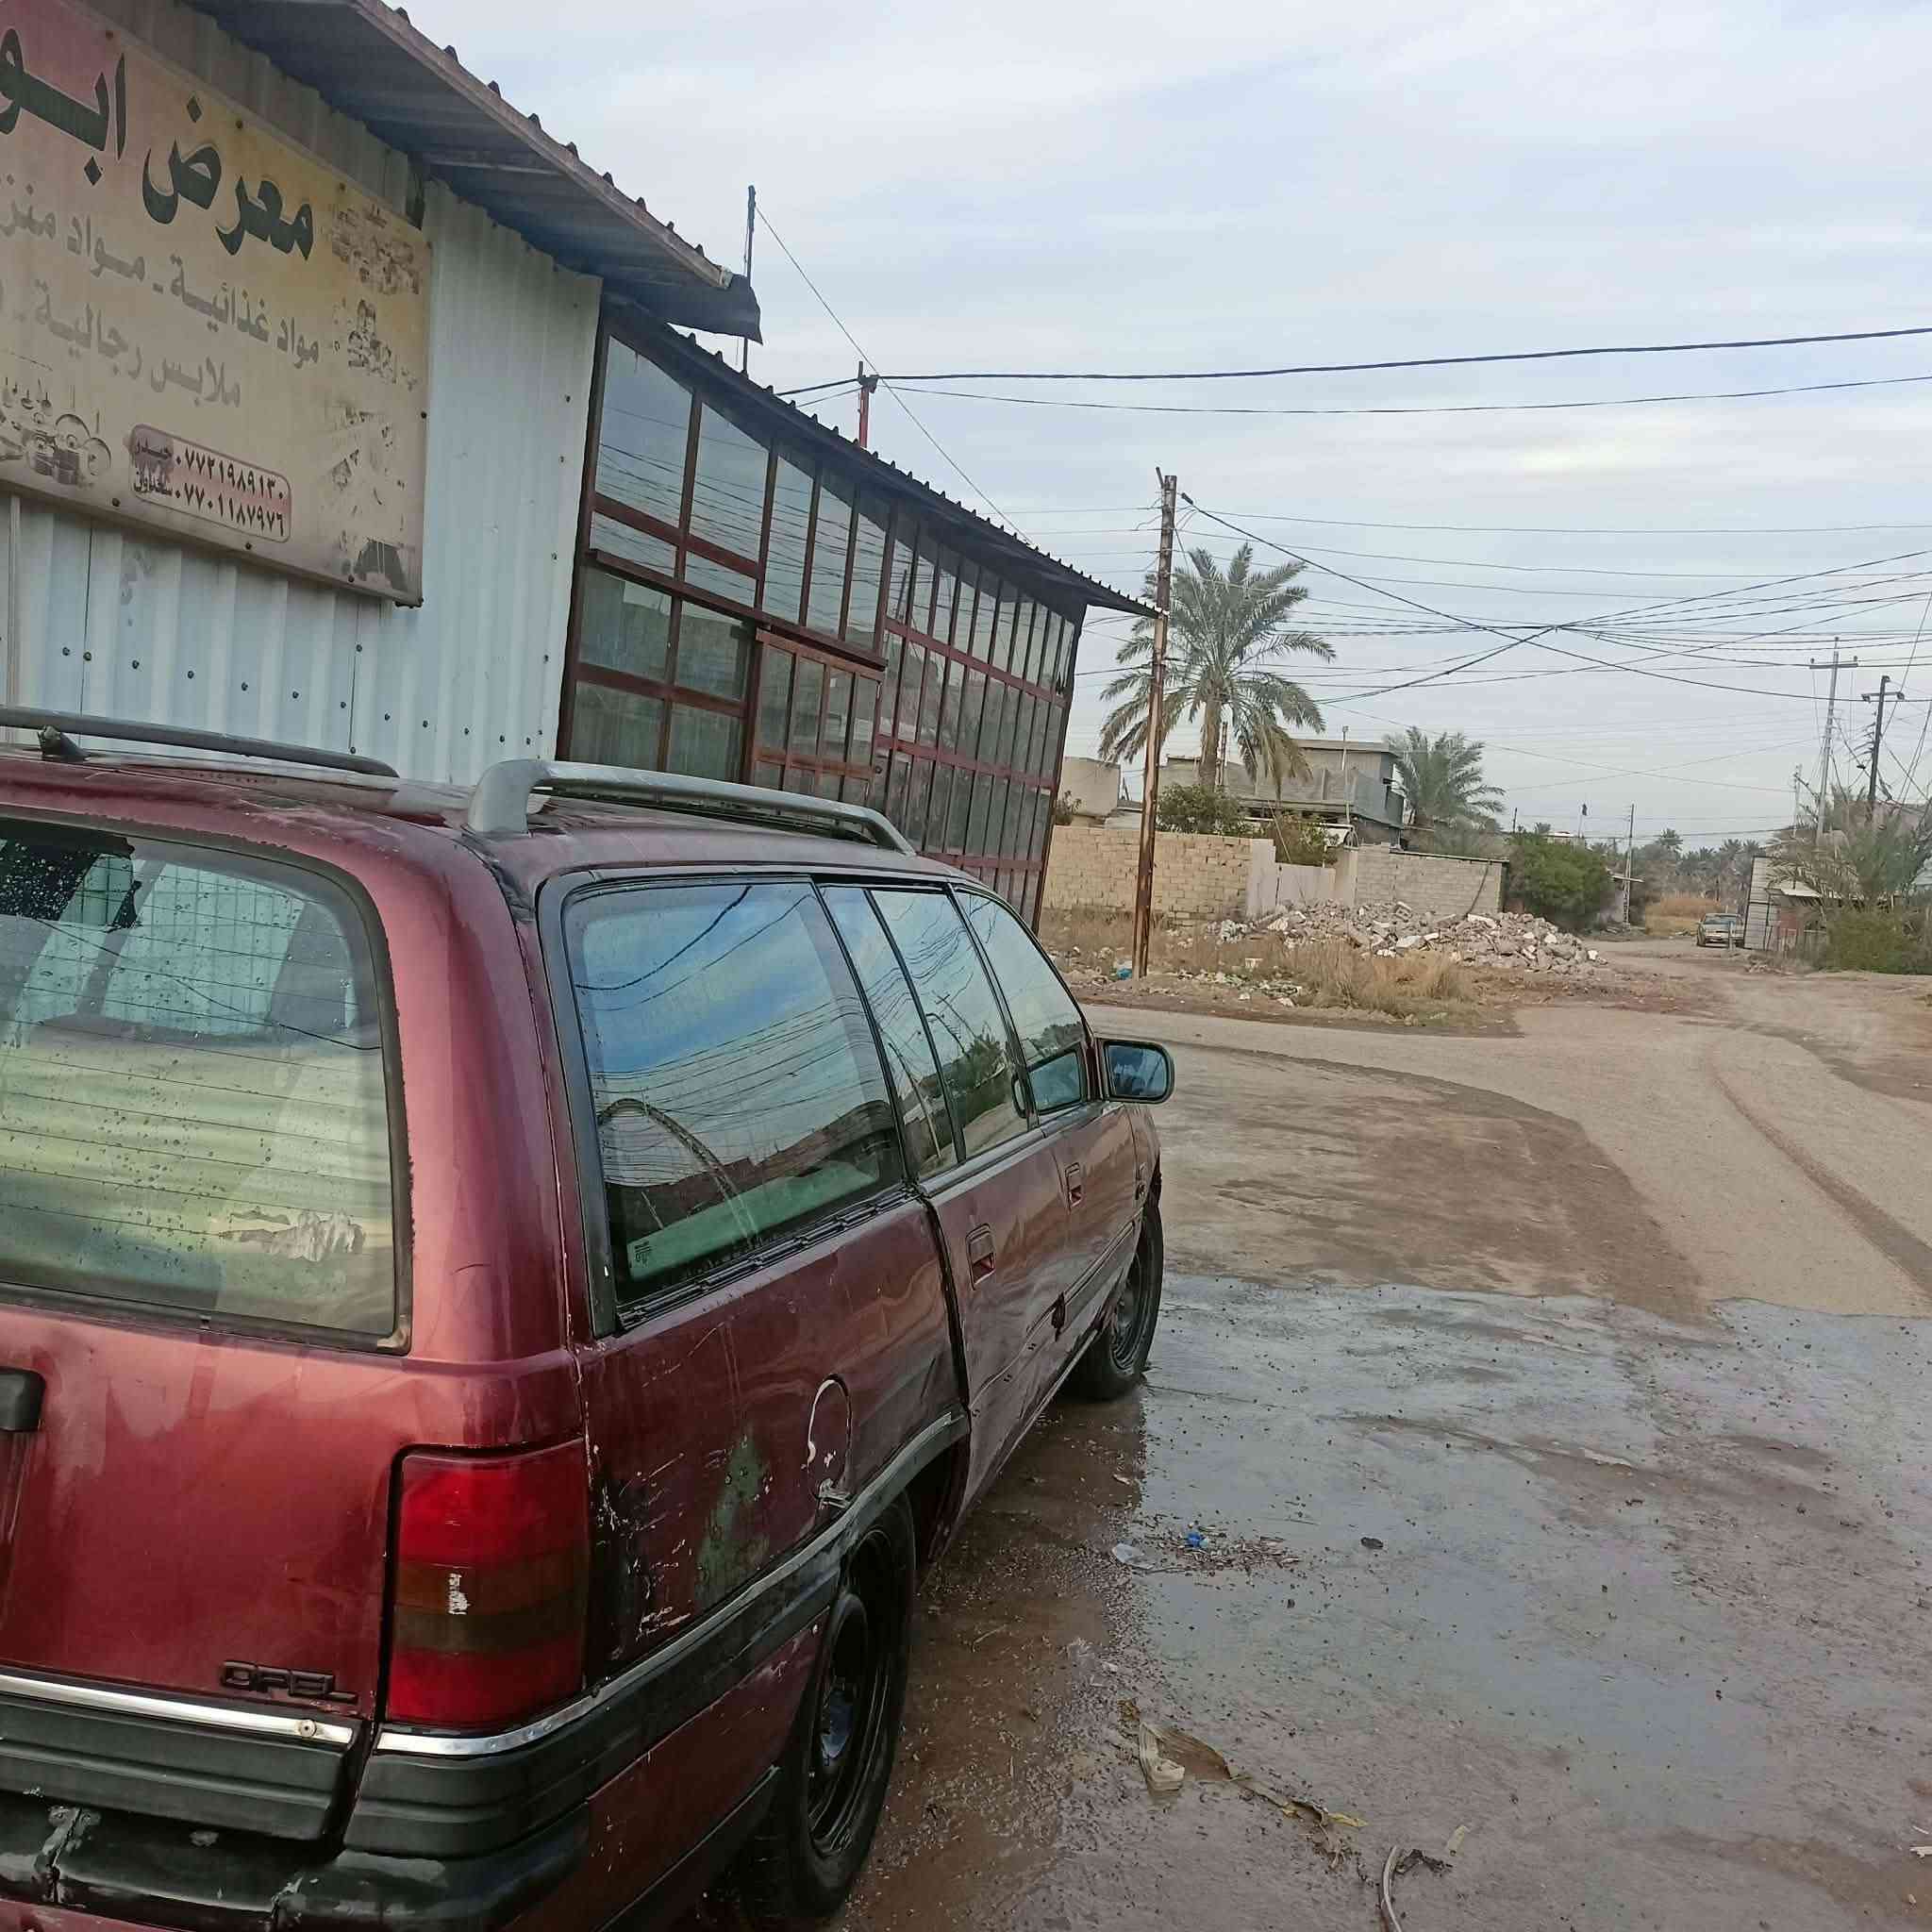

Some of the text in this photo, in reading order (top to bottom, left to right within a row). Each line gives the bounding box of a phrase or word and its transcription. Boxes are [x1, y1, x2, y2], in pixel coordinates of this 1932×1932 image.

[142, 93, 313, 261] معرض
[67, 215, 145, 282] مواد
[170, 254, 271, 342] غذائية
[35, 279, 241, 408] ملابس رجالية
[276, 317, 319, 369] مواد
[220, 1660, 358, 1704] OPEL
